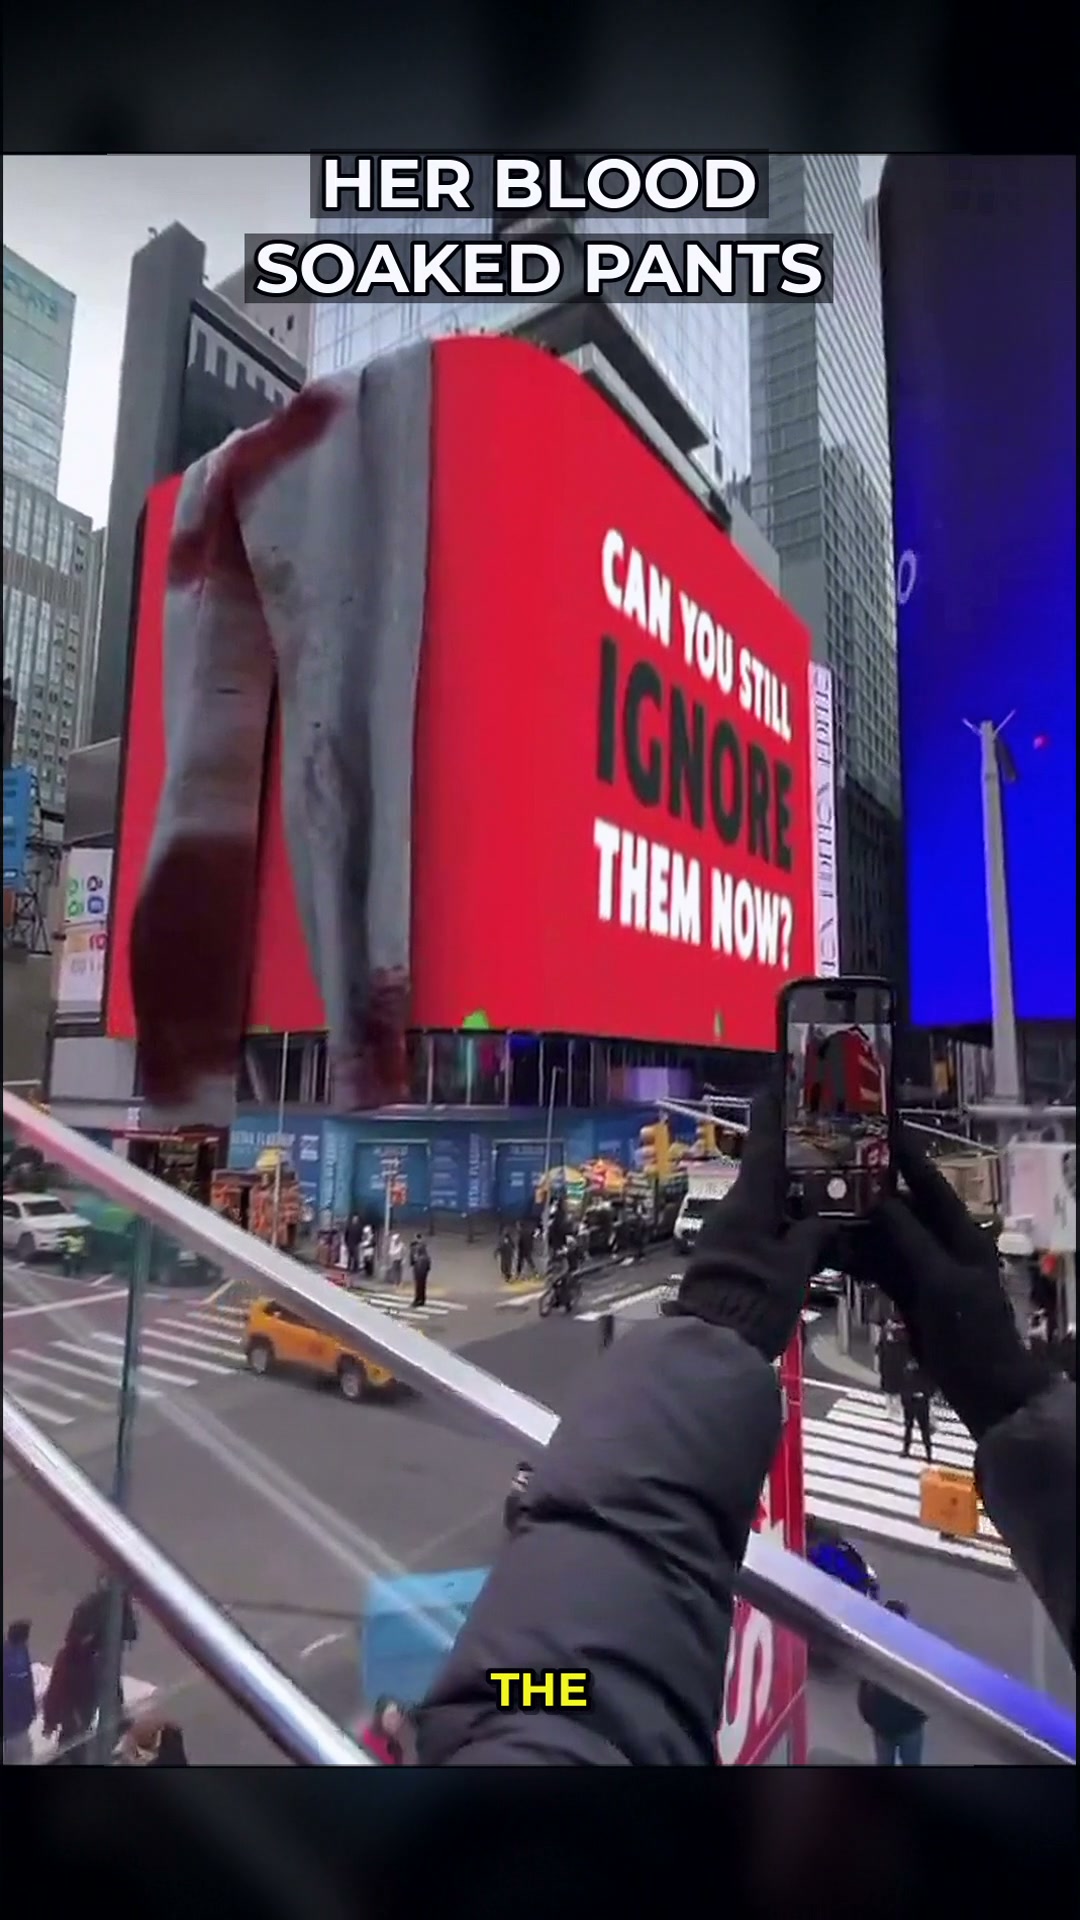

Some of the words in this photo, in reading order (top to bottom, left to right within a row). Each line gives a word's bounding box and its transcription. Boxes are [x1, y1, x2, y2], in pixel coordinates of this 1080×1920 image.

[601, 528, 672, 648] CAN
[679, 590, 735, 695] YOU
[738, 646, 793, 743] STILL
[595, 634, 794, 873] IGNORE
[592, 816, 702, 946] THEM
[710, 867, 794, 970] NOW?
